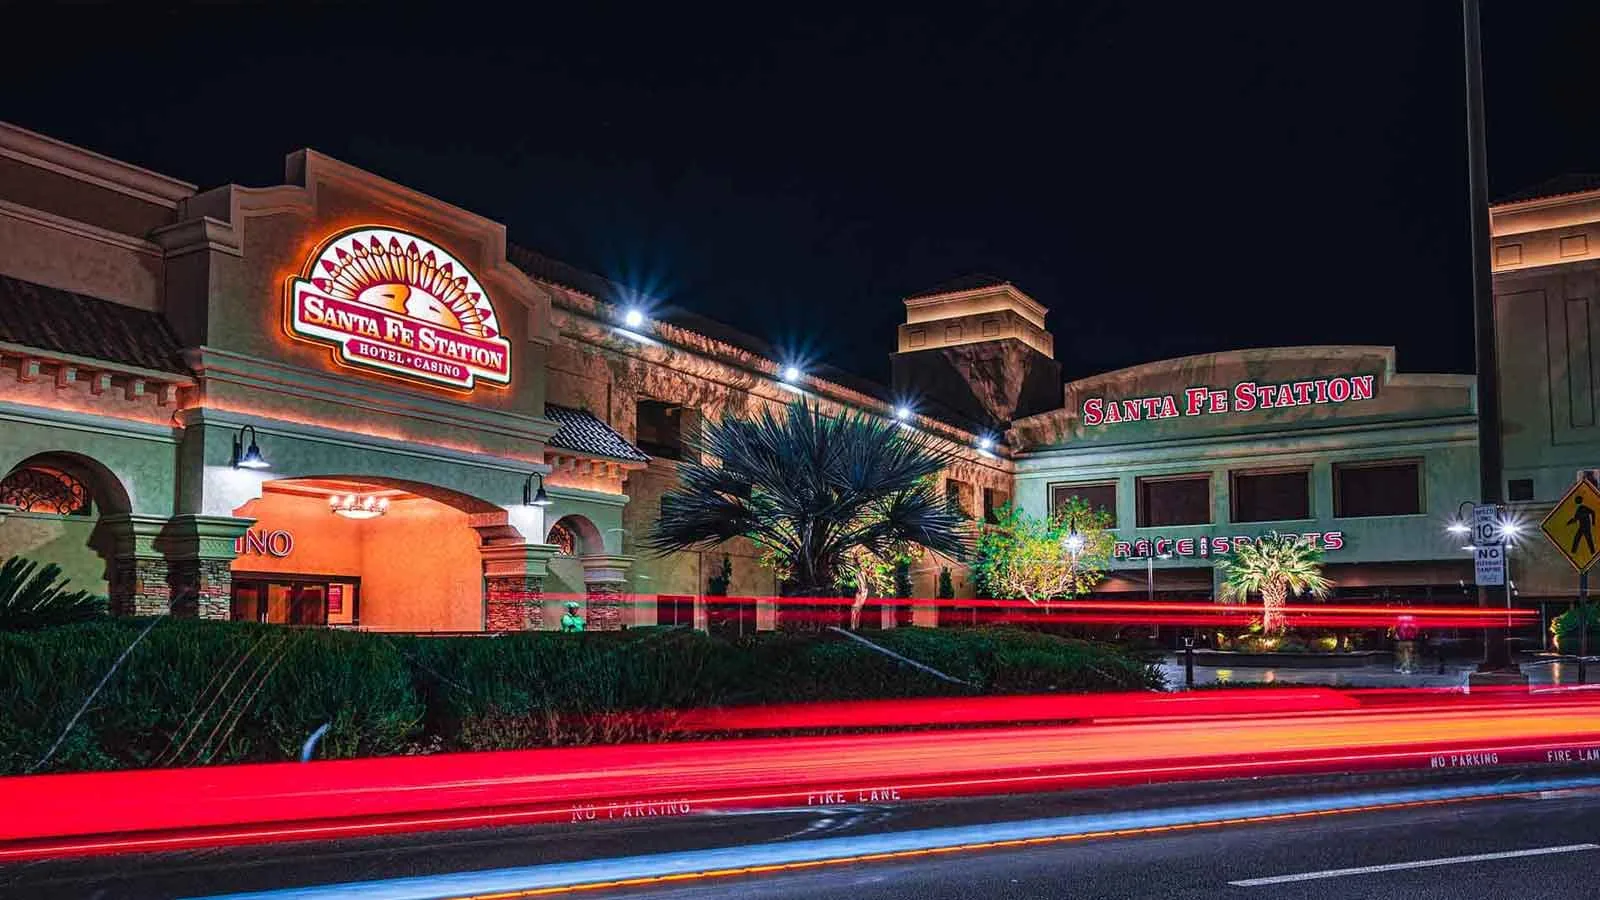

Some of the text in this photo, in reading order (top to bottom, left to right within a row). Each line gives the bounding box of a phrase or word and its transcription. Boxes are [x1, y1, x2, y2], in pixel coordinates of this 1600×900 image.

[304, 296, 503, 369] SANTA FE STATION
[359, 343, 461, 377] HOTEL CASINO
[1083, 375, 1374, 426] SANTA FE STATION
[1477, 523, 1493, 538] 10
[1113, 538, 1194, 558] RACE
[1478, 549, 1499, 559] NO
[1431, 752, 1498, 768] NO PARKING
[1547, 750, 1572, 762] FIRE
[808, 787, 901, 805] FIRE LANE
[570, 799, 691, 822] NO PARKING
